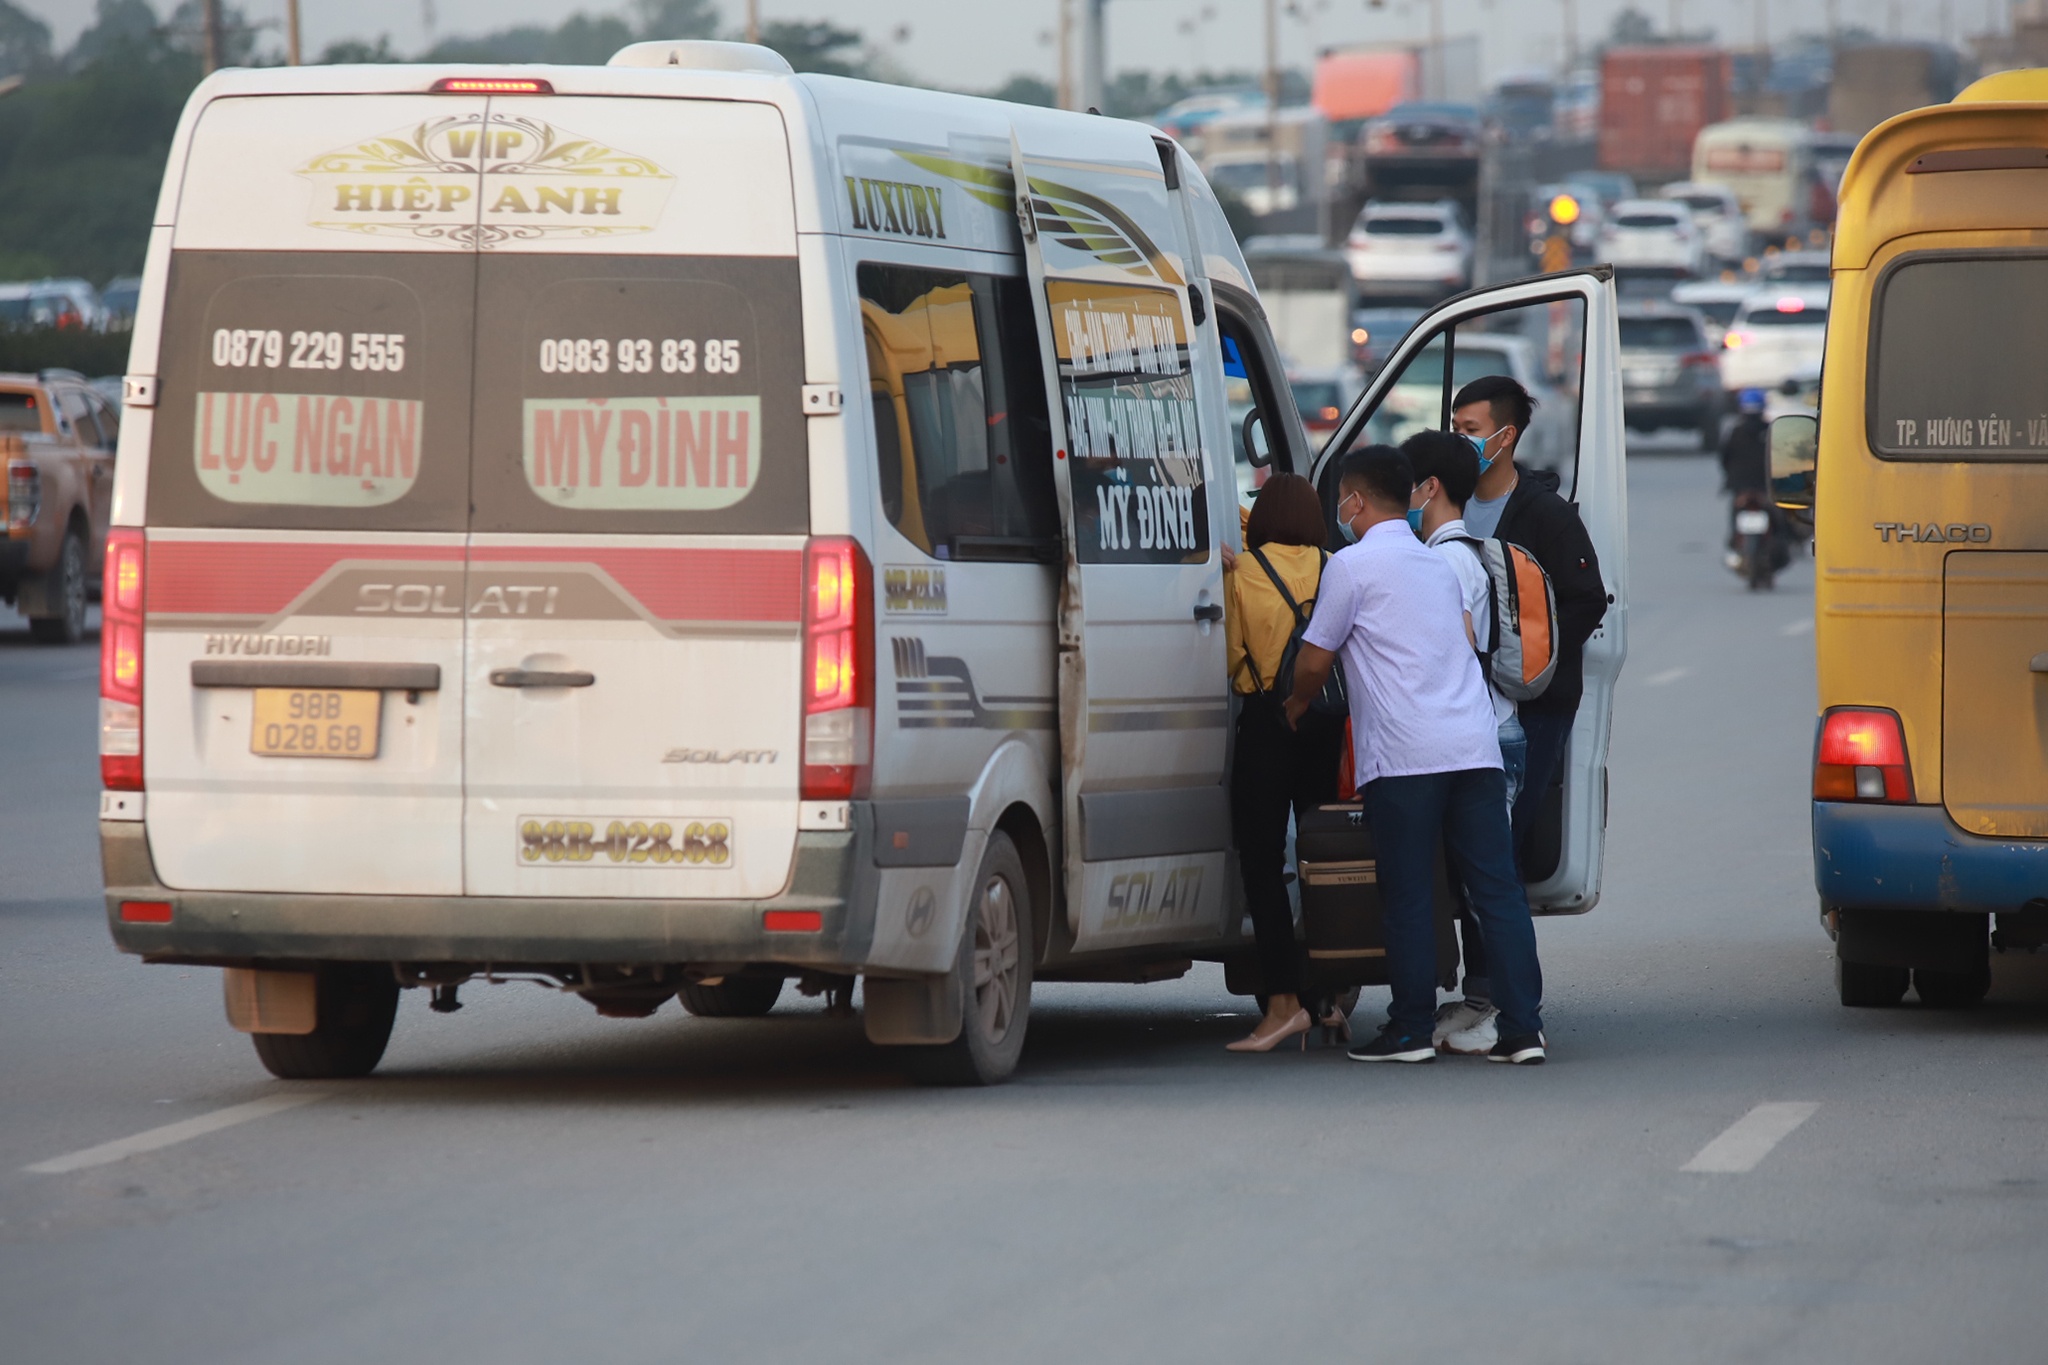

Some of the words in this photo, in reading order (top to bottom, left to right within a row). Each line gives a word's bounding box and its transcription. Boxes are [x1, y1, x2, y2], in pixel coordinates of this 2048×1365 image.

[446, 129, 524, 159] VIP
[333, 176, 471, 220] HIỆP
[489, 185, 622, 215] ANH
[843, 176, 946, 239] LUXURY
[212, 329, 283, 368] 0879
[288, 331, 344, 369] 229
[350, 333, 405, 371] 555
[540, 339, 610, 373] 0983
[616, 339, 653, 373] 93
[660, 339, 697, 373] 83
[704, 339, 740, 374] 85
[201, 392, 280, 484] LỤC
[293, 395, 417, 490] NGẠN
[534, 398, 613, 488] MỸ
[617, 396, 750, 488] ĐÌNH
[1896, 419, 1919, 446] TP.
[1926, 416, 1973, 446] HƯNG
[1978, 412, 2011, 446] YÊN
[1096, 466, 1131, 550] MỸ
[1136, 466, 1196, 550] ĐÌNH
[1874, 522, 1992, 543] THACO
[354, 583, 560, 614] SOLATI
[204, 633, 332, 656] HYUNDAI
[288, 692, 342, 719] 98B
[264, 723, 362, 751] 028.68
[660, 748, 779, 764] SOLATI
[521, 820, 729, 864] 98B-028.68
[1101, 866, 1204, 929] SOLATI
